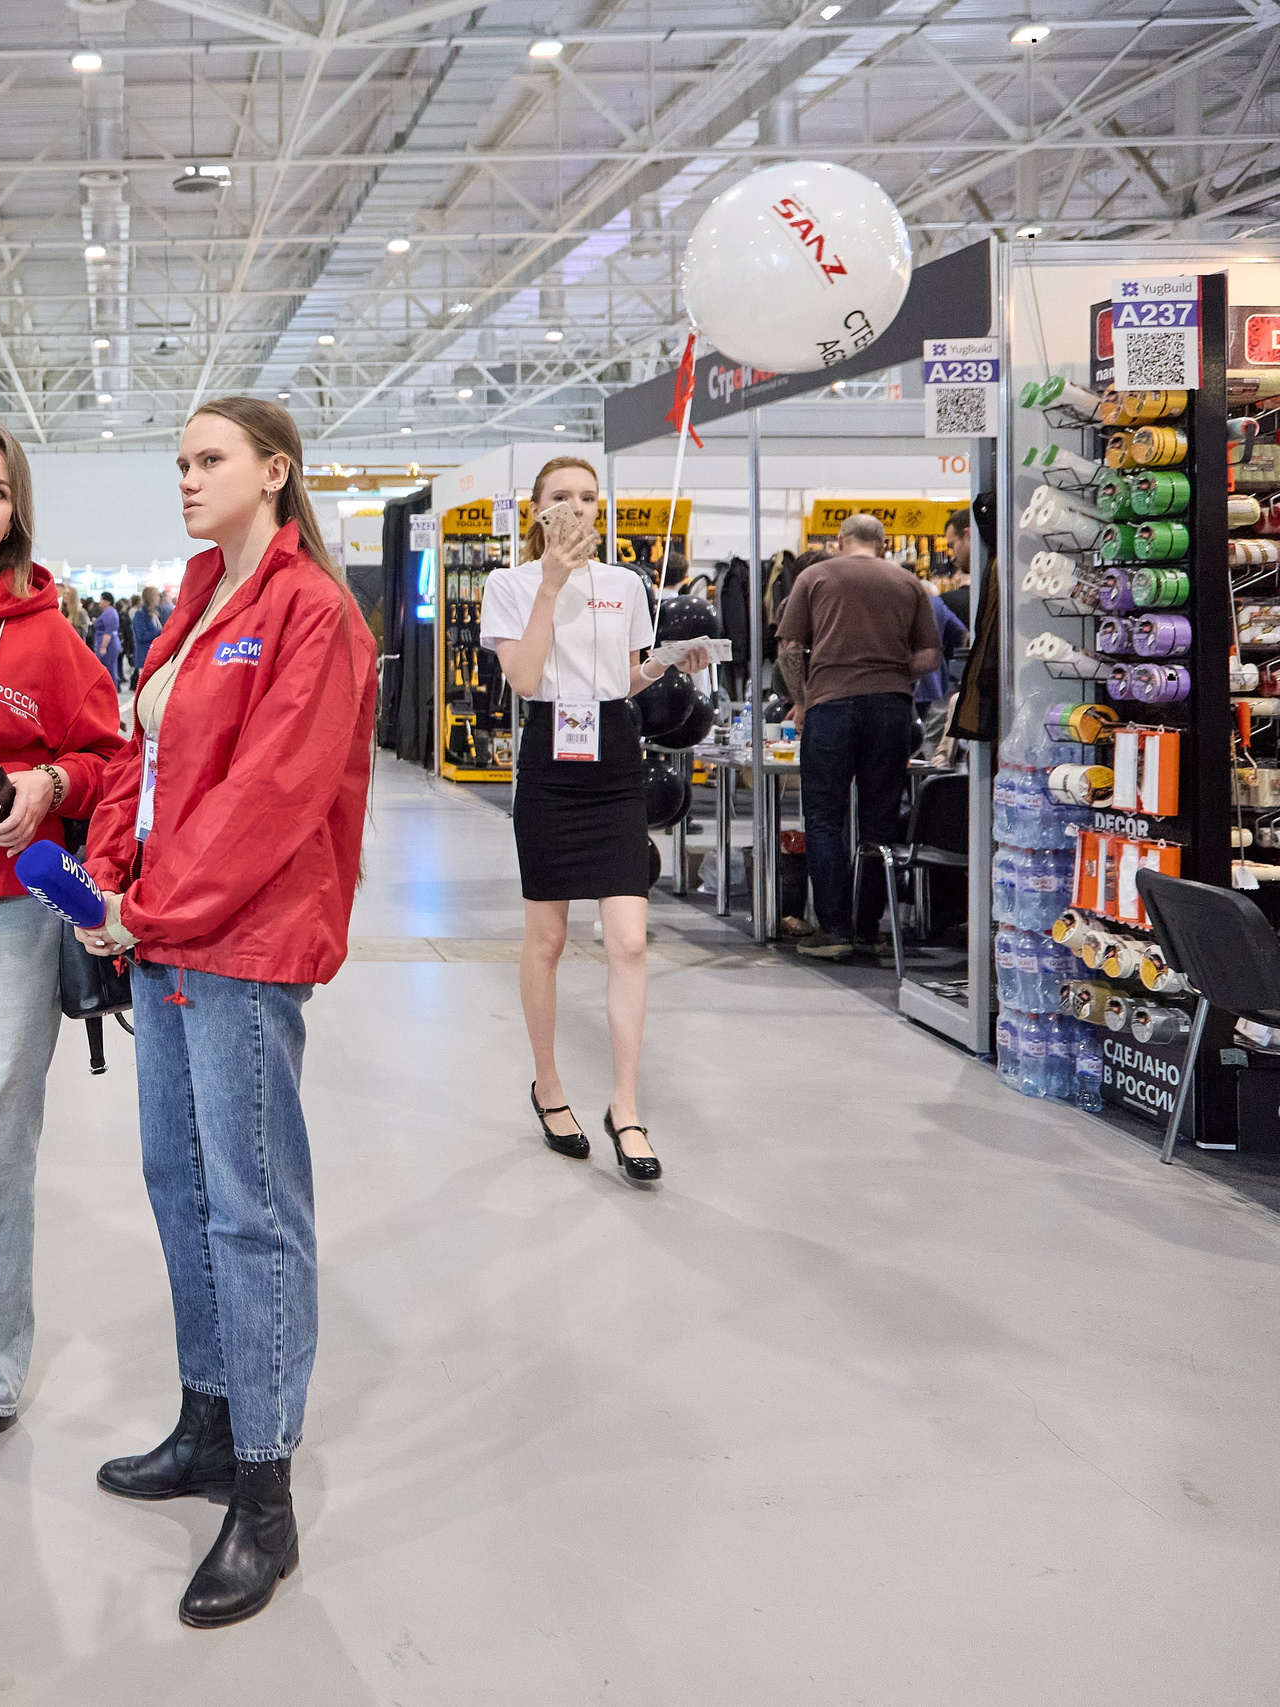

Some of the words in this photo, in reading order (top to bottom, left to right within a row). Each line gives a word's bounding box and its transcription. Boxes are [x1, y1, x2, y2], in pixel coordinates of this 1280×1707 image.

[772, 198, 848, 284] SANZ
[1142, 282, 1192, 296] YugBuild
[1117, 303, 1193, 327] A237
[950, 344, 992, 356] YugBuild
[928, 361, 993, 382] A239
[587, 601, 623, 609] SANZ
[1095, 811, 1149, 837] DECOR
[1104, 1038, 1180, 1086] СДЕЛАНО
[1104, 1064, 1113, 1085] В
